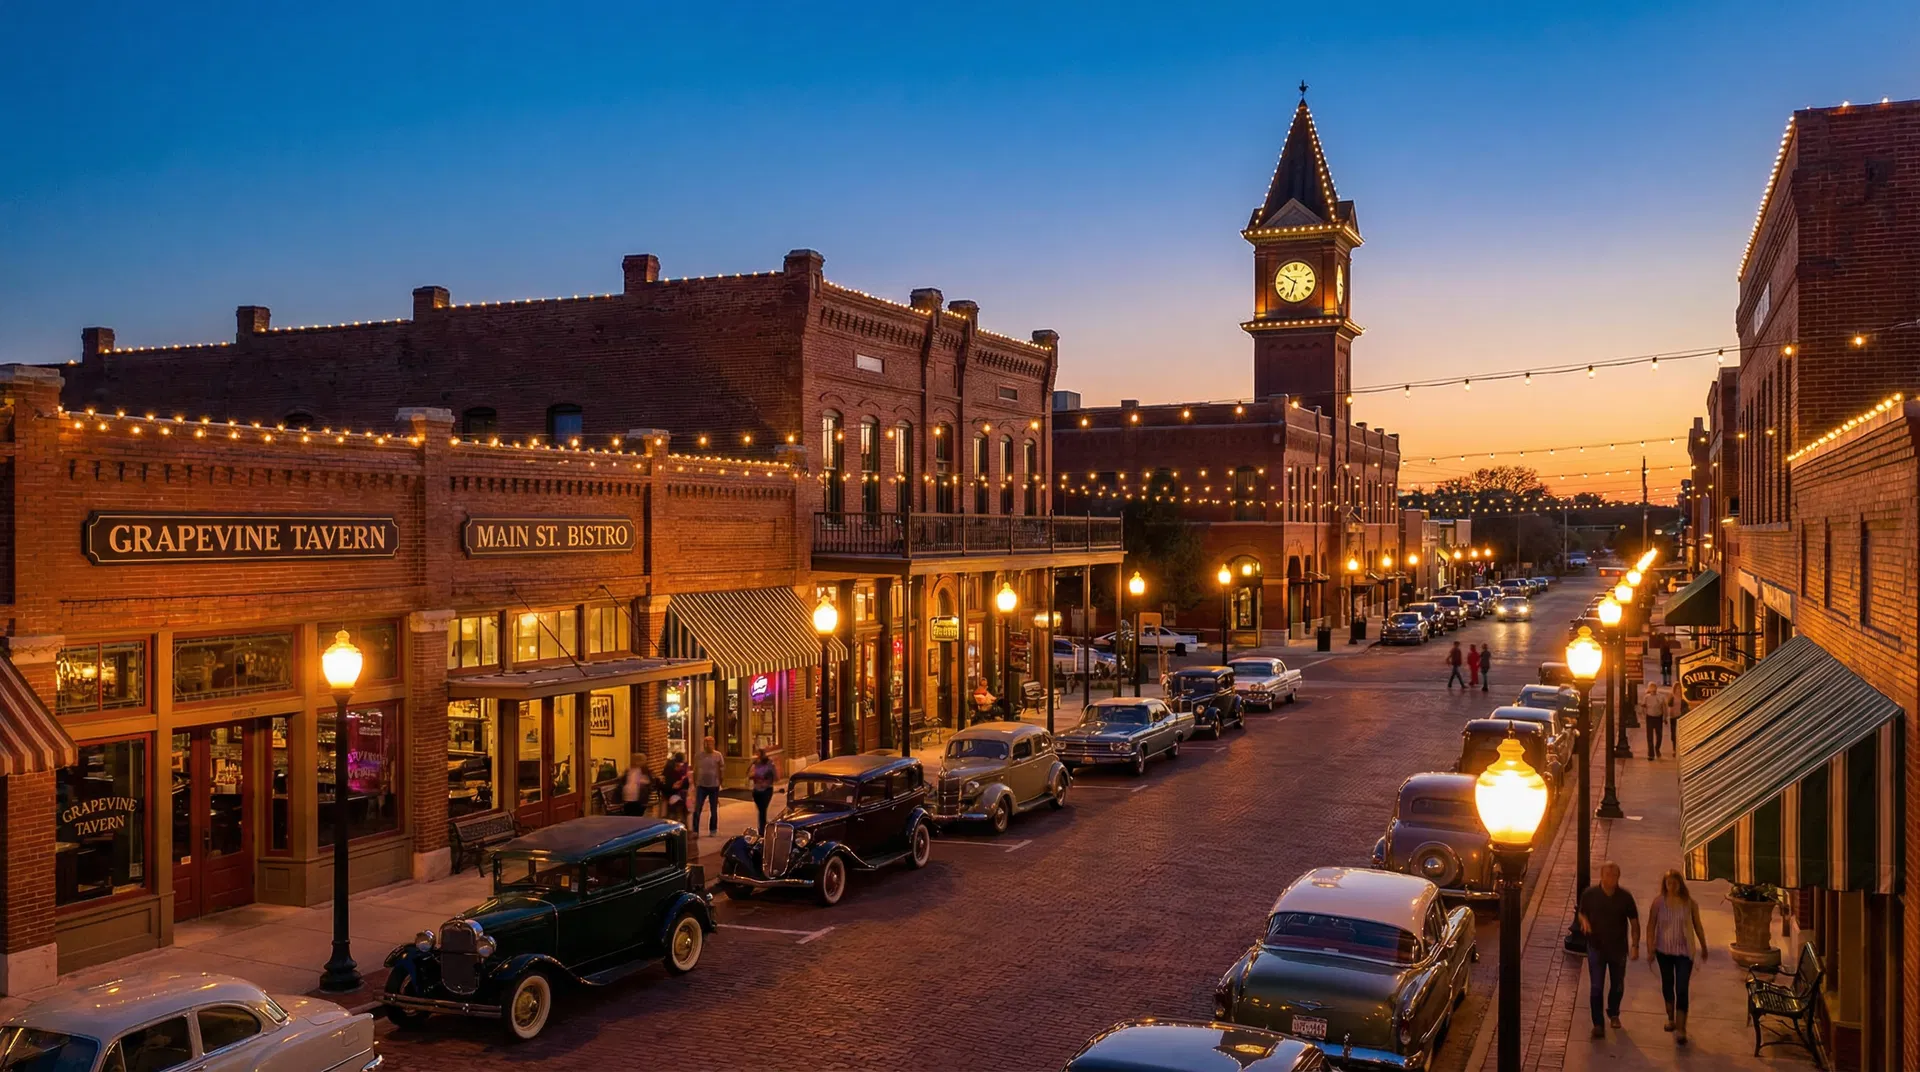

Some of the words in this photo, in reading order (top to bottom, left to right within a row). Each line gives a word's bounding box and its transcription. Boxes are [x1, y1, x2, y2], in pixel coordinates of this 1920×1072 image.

[108, 524, 282, 553] GRAPEVINE
[290, 525, 387, 550] TAVERN
[476, 525, 529, 548] MAIN
[535, 525, 561, 547] ST.
[567, 525, 628, 546] BISTRO
[62, 796, 138, 823] GRAPEVINE
[74, 814, 125, 836] TAVERN
